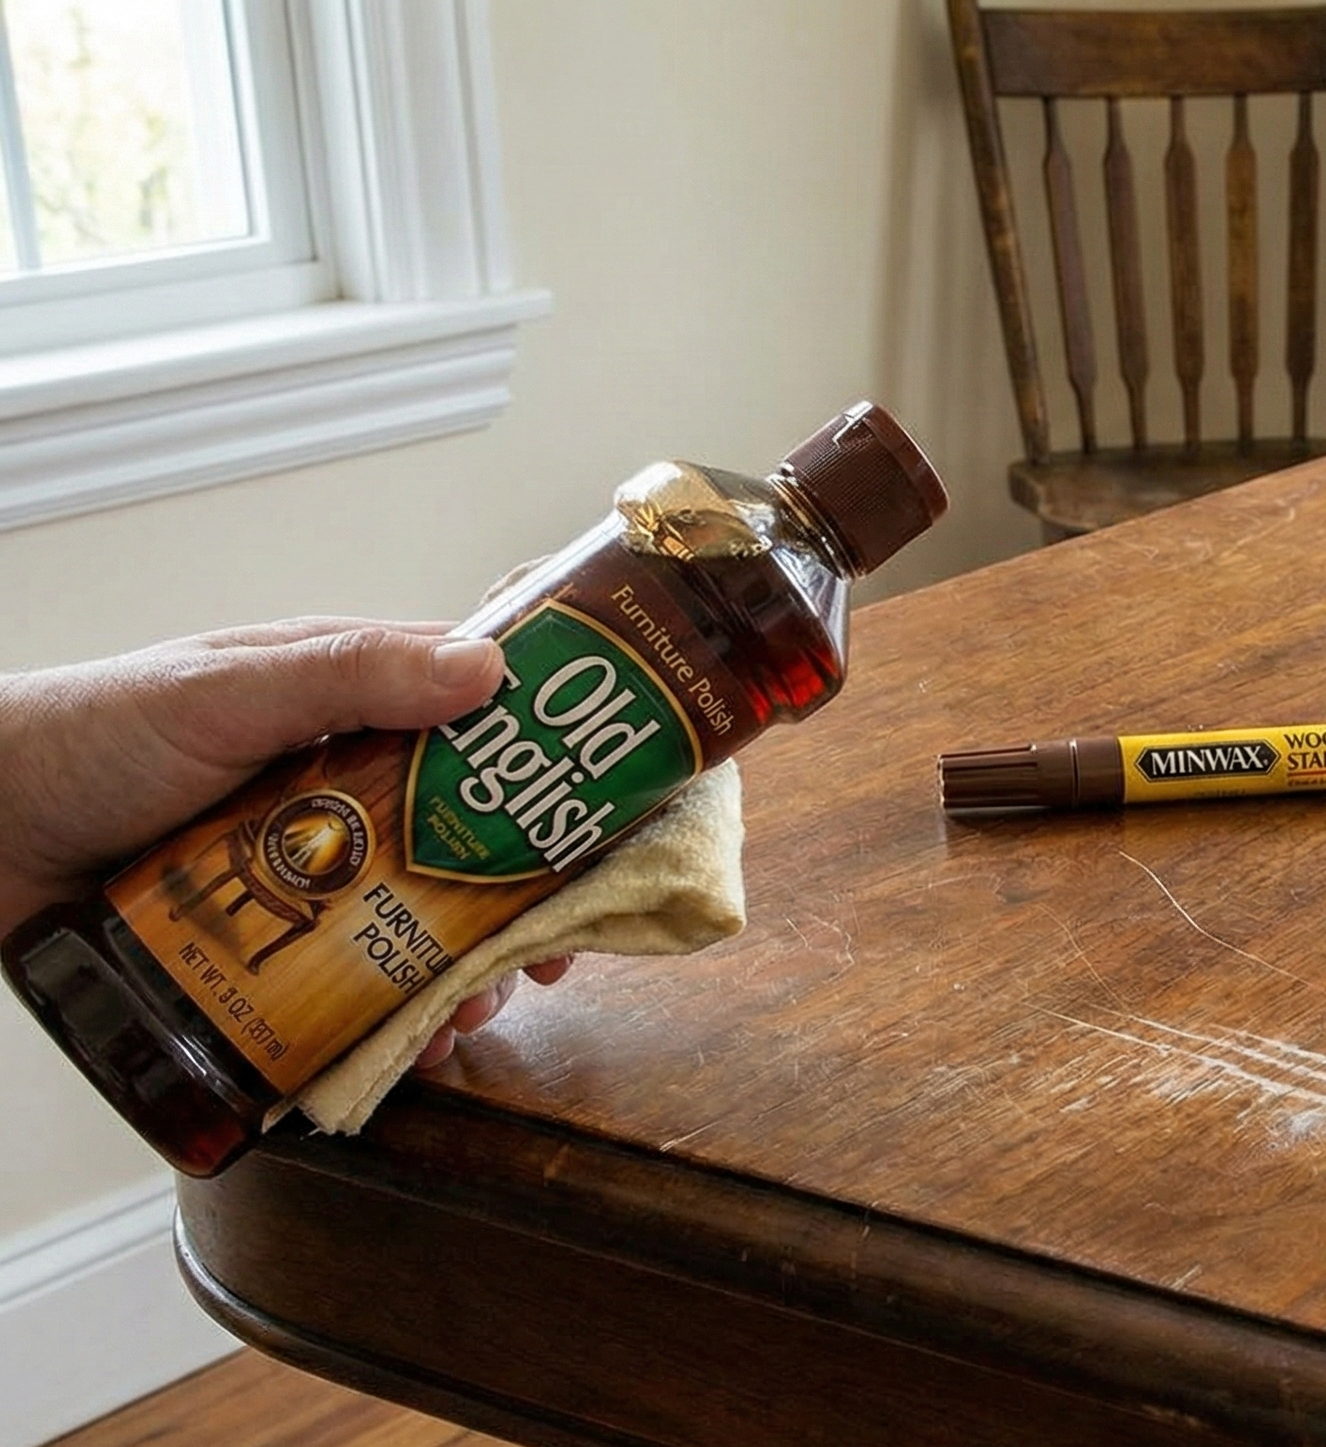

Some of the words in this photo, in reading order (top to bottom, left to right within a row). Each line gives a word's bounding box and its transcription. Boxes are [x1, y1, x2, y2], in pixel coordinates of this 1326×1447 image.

[611, 584, 694, 683] Furniture
[688, 677, 735, 736] Polish
[533, 655, 661, 780] Old
[1151, 745, 1264, 776] MINWAX
[179, 942, 210, 971] NET
[200, 964, 227, 996] WT.
[353, 922, 426, 994] POLISH
